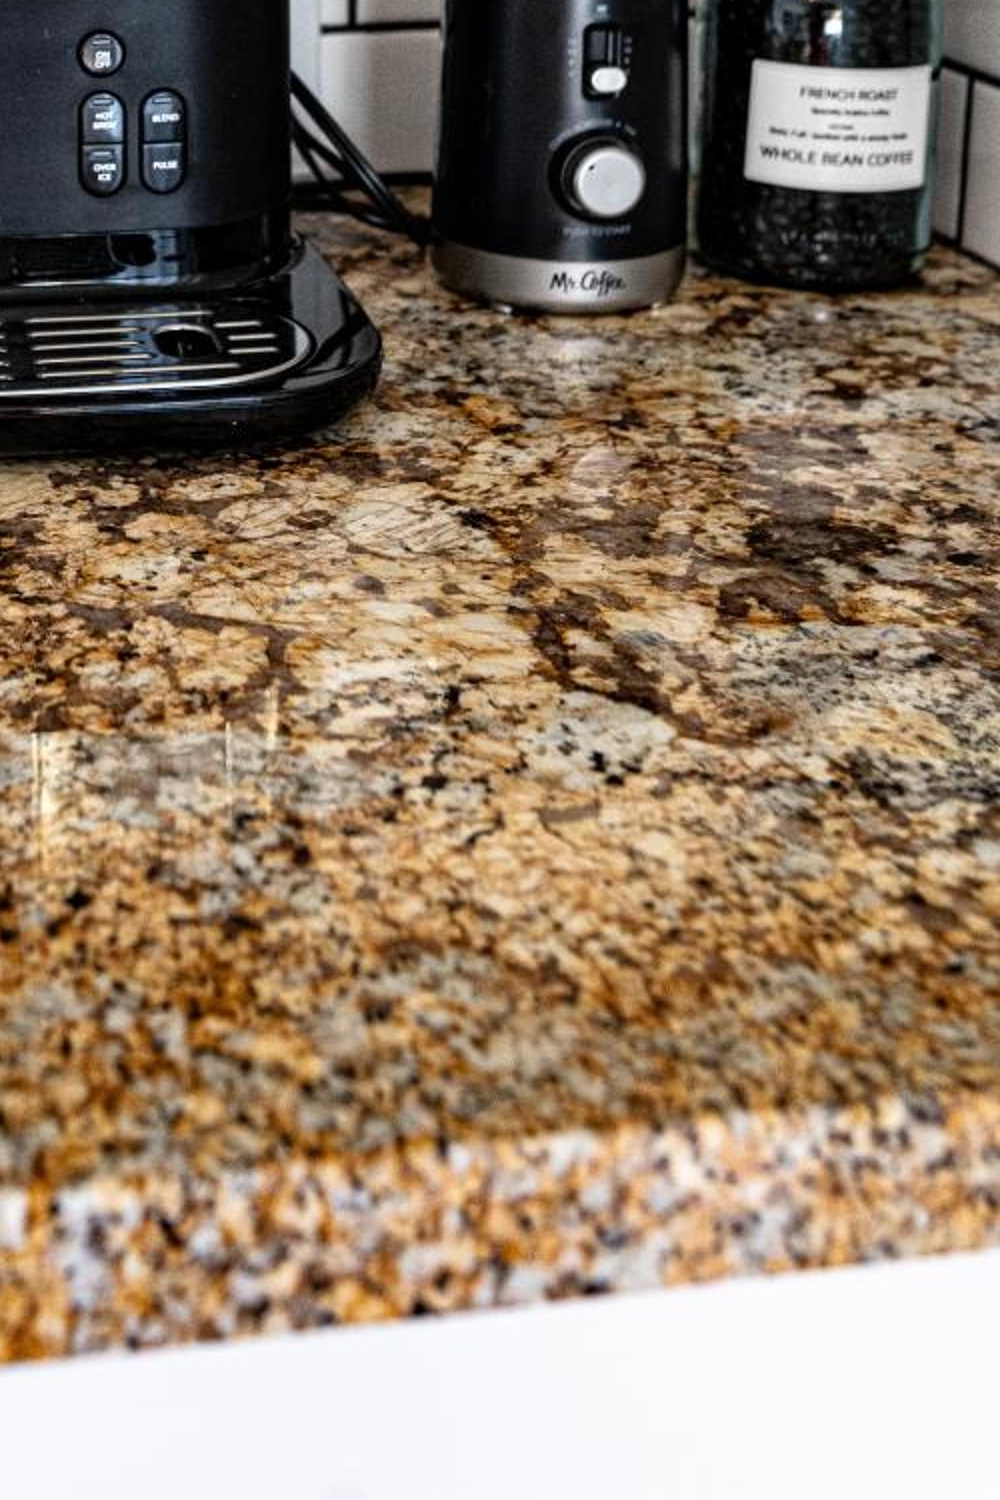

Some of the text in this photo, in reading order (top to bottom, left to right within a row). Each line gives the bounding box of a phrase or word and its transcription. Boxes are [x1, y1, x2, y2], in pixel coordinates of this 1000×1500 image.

[800, 86, 855, 100] FRENCH
[760, 145, 914, 167] WHOLE BEAN COFFEE
